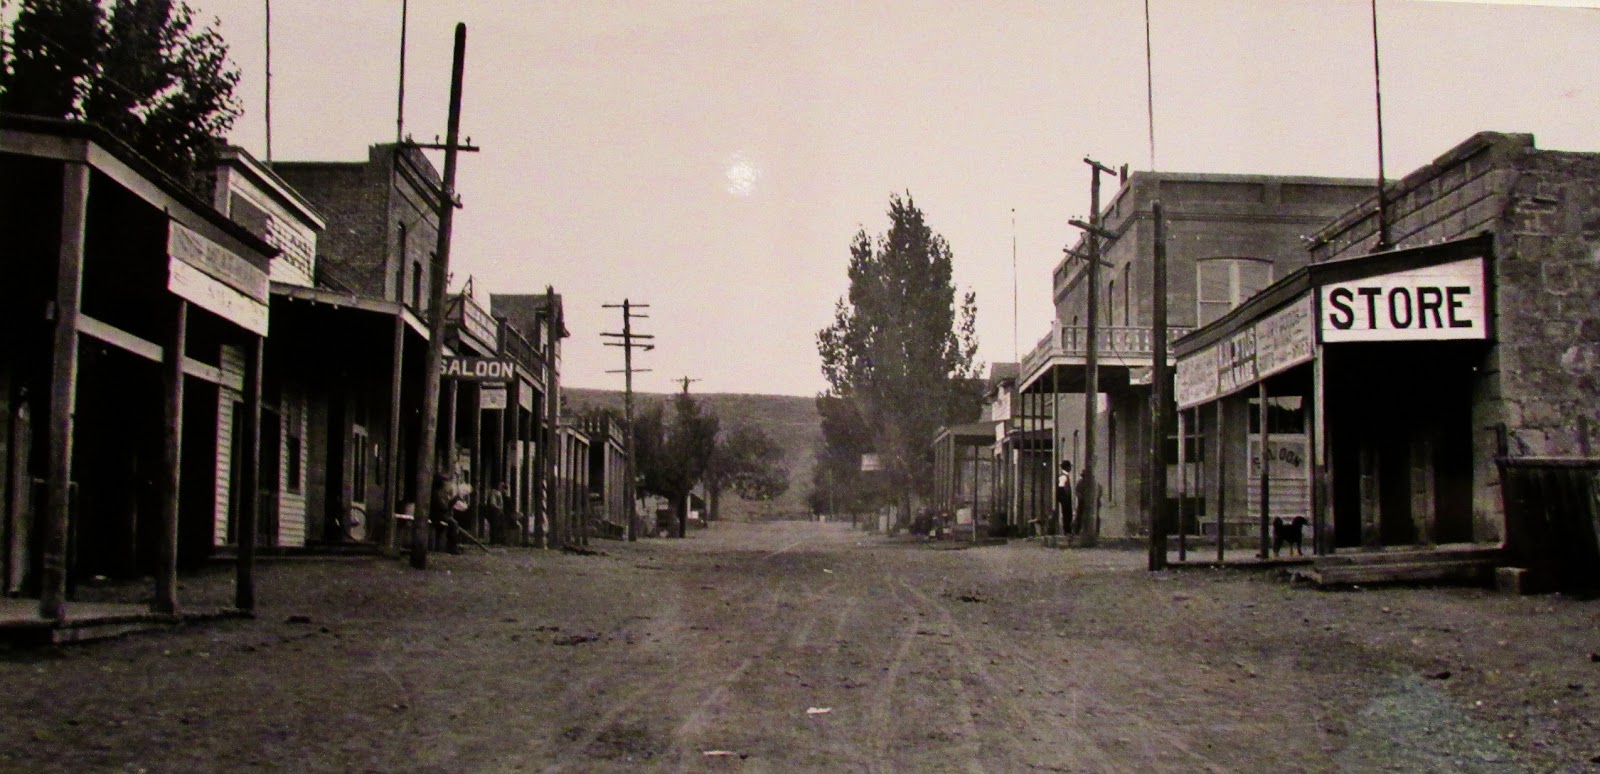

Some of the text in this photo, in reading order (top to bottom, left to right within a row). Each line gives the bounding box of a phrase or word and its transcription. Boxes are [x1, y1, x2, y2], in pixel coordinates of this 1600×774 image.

[1329, 286, 1472, 330] STORE
[440, 358, 513, 379] SALOON
[1251, 447, 1303, 469] SLOON
